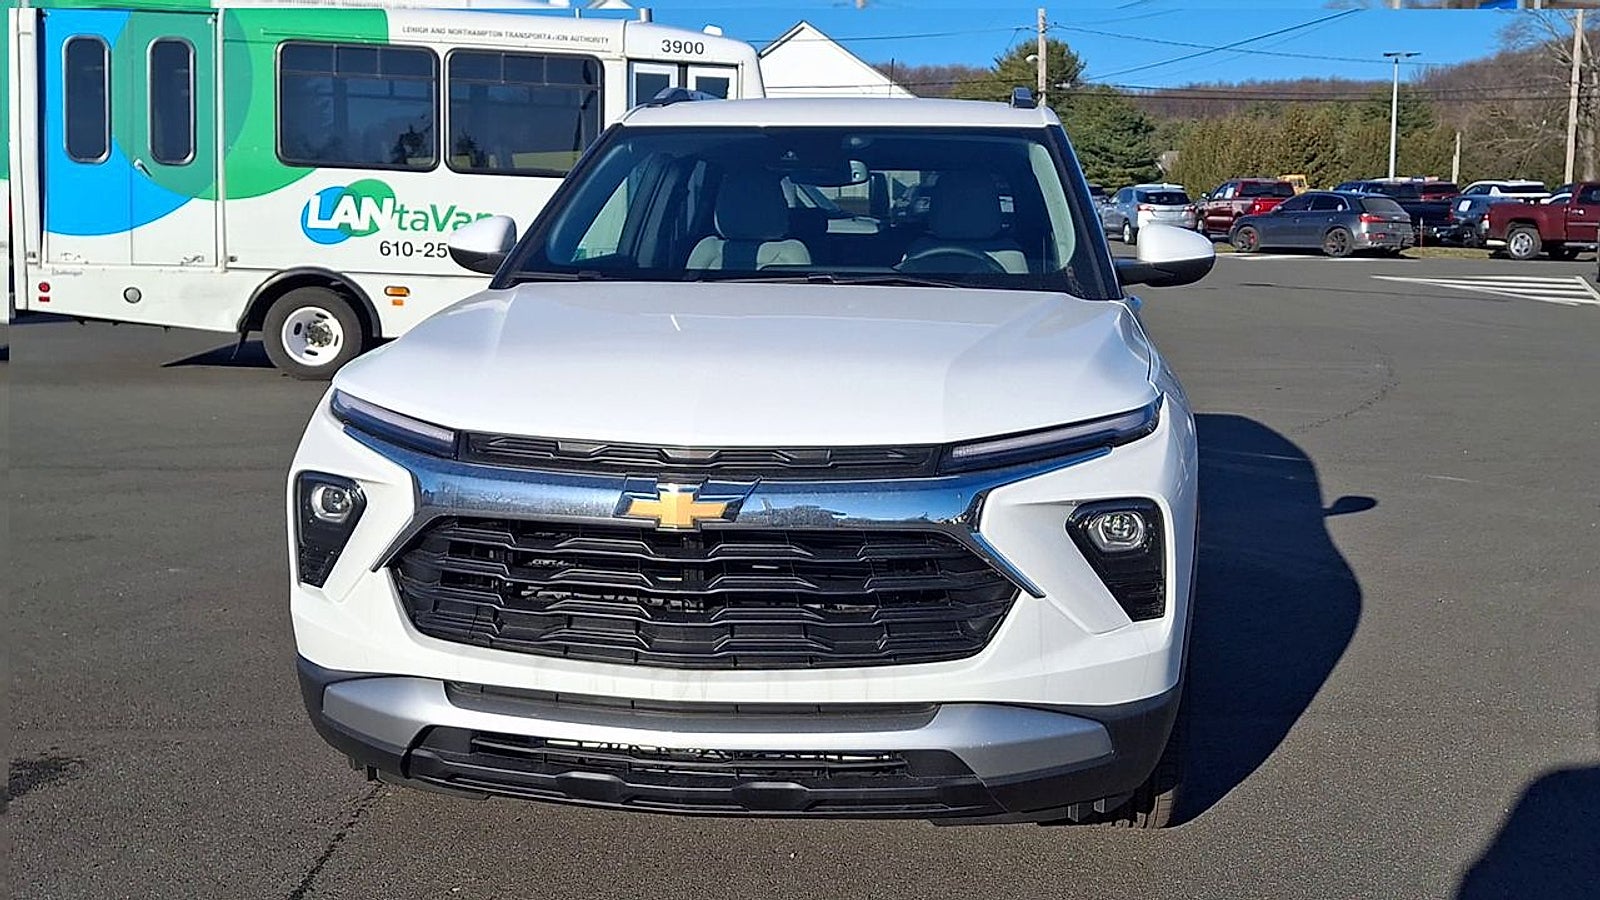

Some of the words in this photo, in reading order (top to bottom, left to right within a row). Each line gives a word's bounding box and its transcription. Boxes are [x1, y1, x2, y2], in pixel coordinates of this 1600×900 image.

[430, 27, 446, 35] AND
[661, 39, 705, 55] 3900
[379, 240, 449, 259] 610-25
